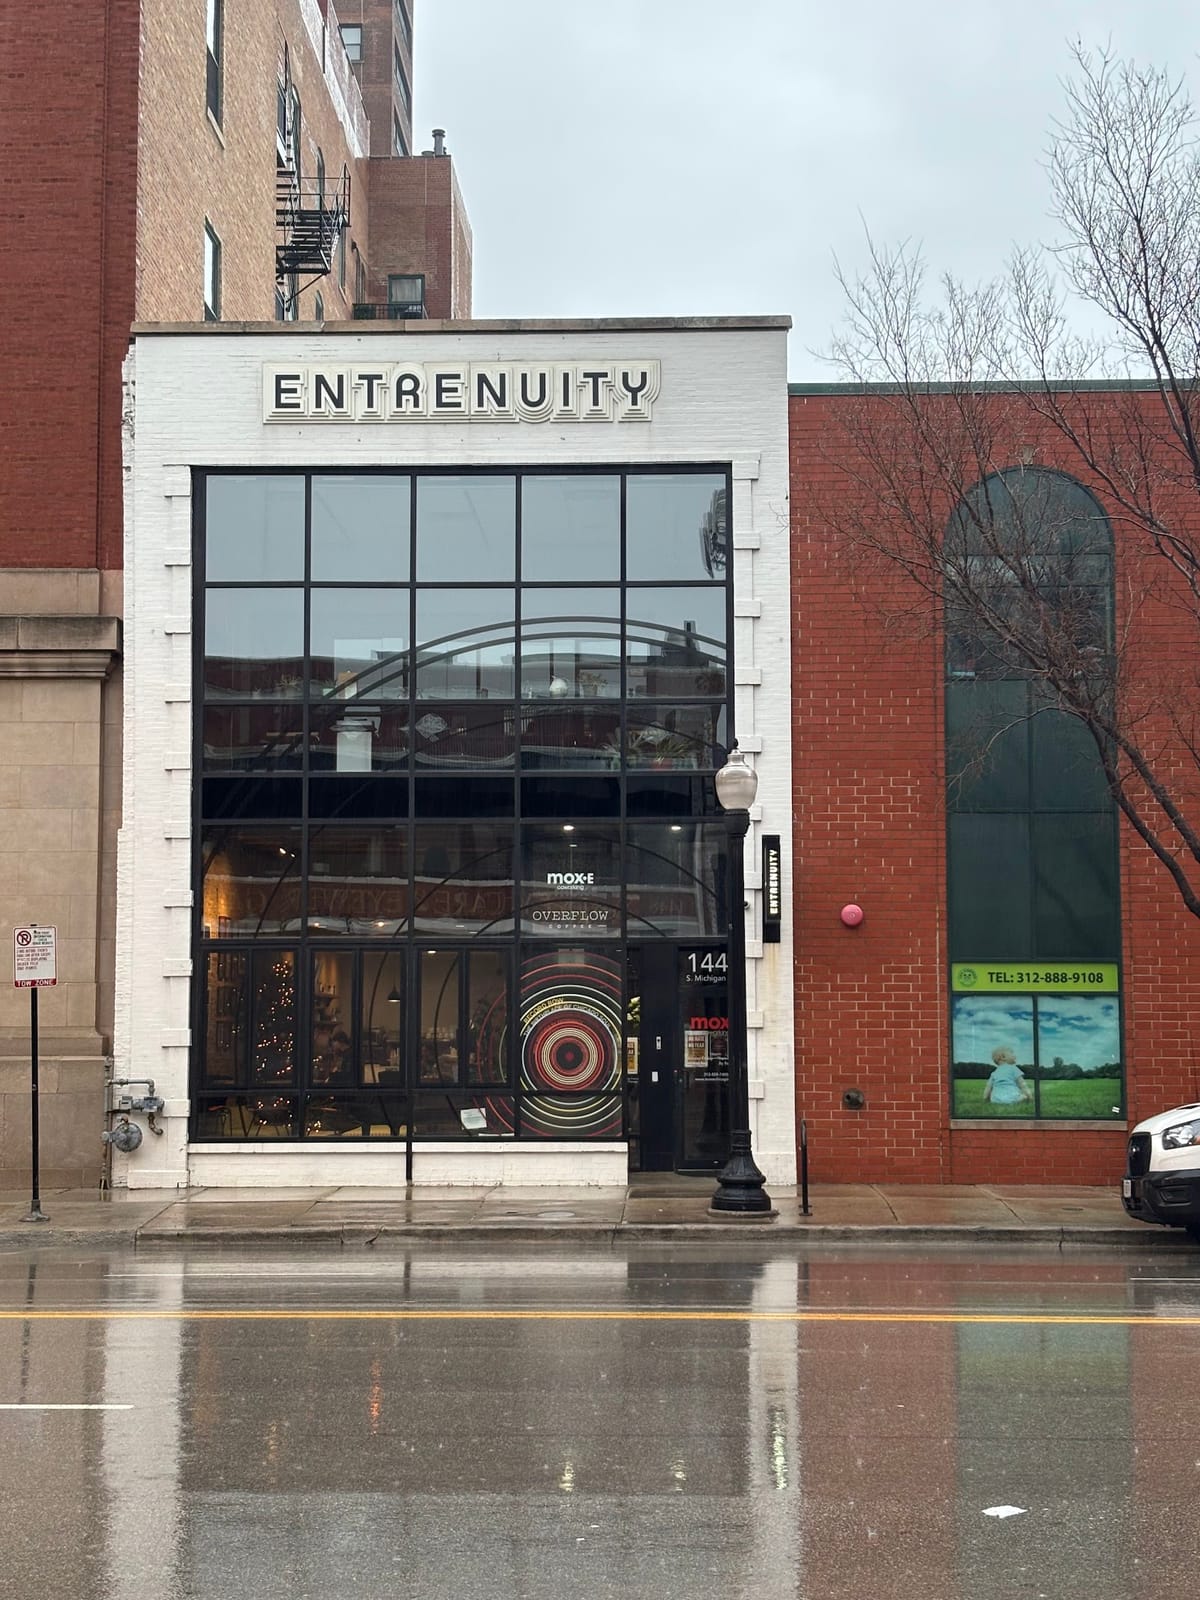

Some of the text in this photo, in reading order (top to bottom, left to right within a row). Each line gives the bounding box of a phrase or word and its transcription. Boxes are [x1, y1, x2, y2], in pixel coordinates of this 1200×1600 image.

[273, 371, 649, 409] ENTRENUITY
[769, 849, 779, 915] ENTRENUITY
[532, 910, 609, 921] OVERFLOW
[36, 978, 54, 986] ZONE
[686, 974, 727, 983] S. Michigan
[987, 971, 1014, 983] TEL:
[1016, 971, 1104, 984] 312-888-9108
